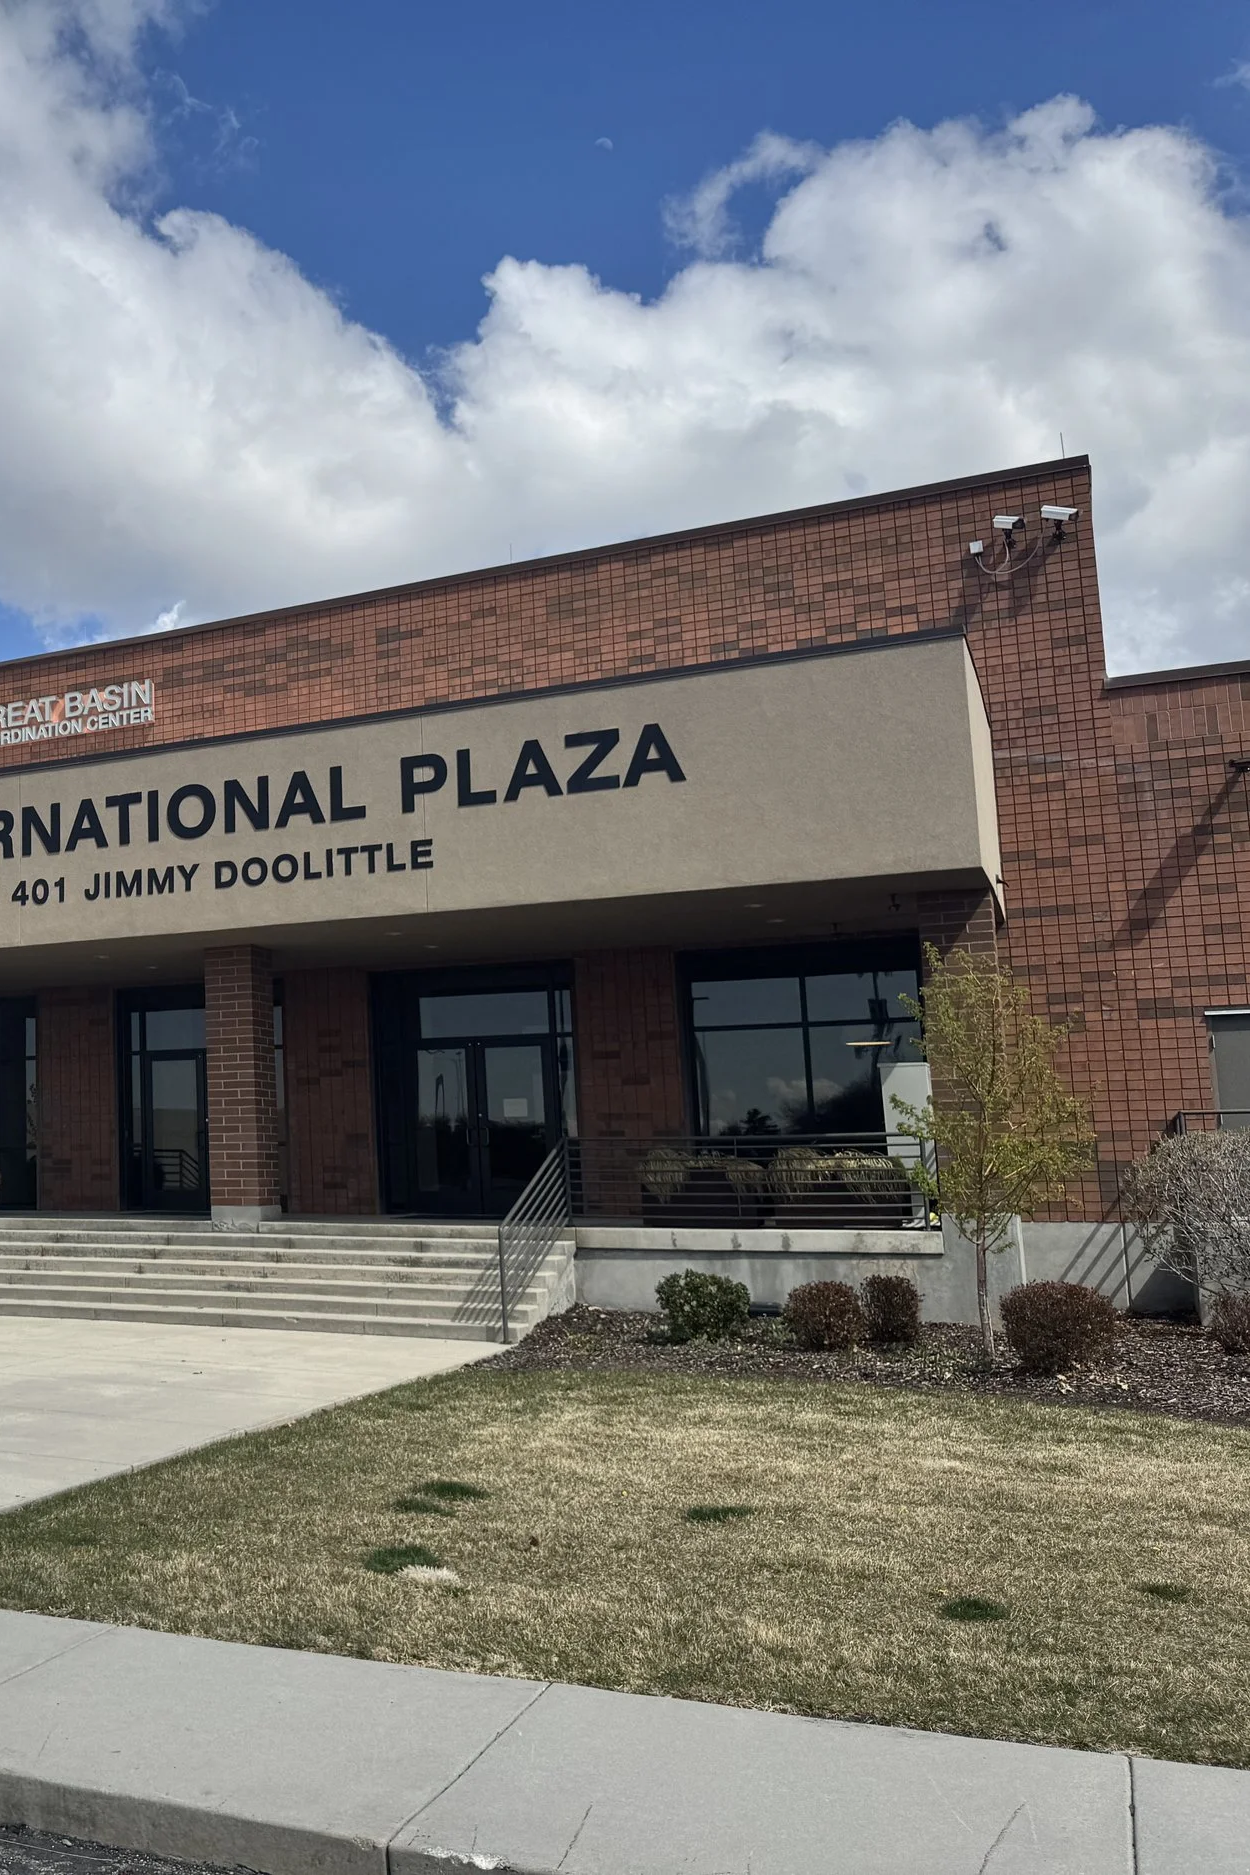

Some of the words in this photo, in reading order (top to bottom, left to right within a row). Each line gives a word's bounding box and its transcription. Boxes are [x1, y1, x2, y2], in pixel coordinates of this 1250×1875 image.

[64, 678, 153, 718] BASIN
[86, 708, 154, 731] CENTER
[400, 723, 687, 814] PLAZA
[11, 876, 66, 906] 401
[84, 863, 201, 900] JIMMY
[214, 838, 434, 889] DOOLITTLE
